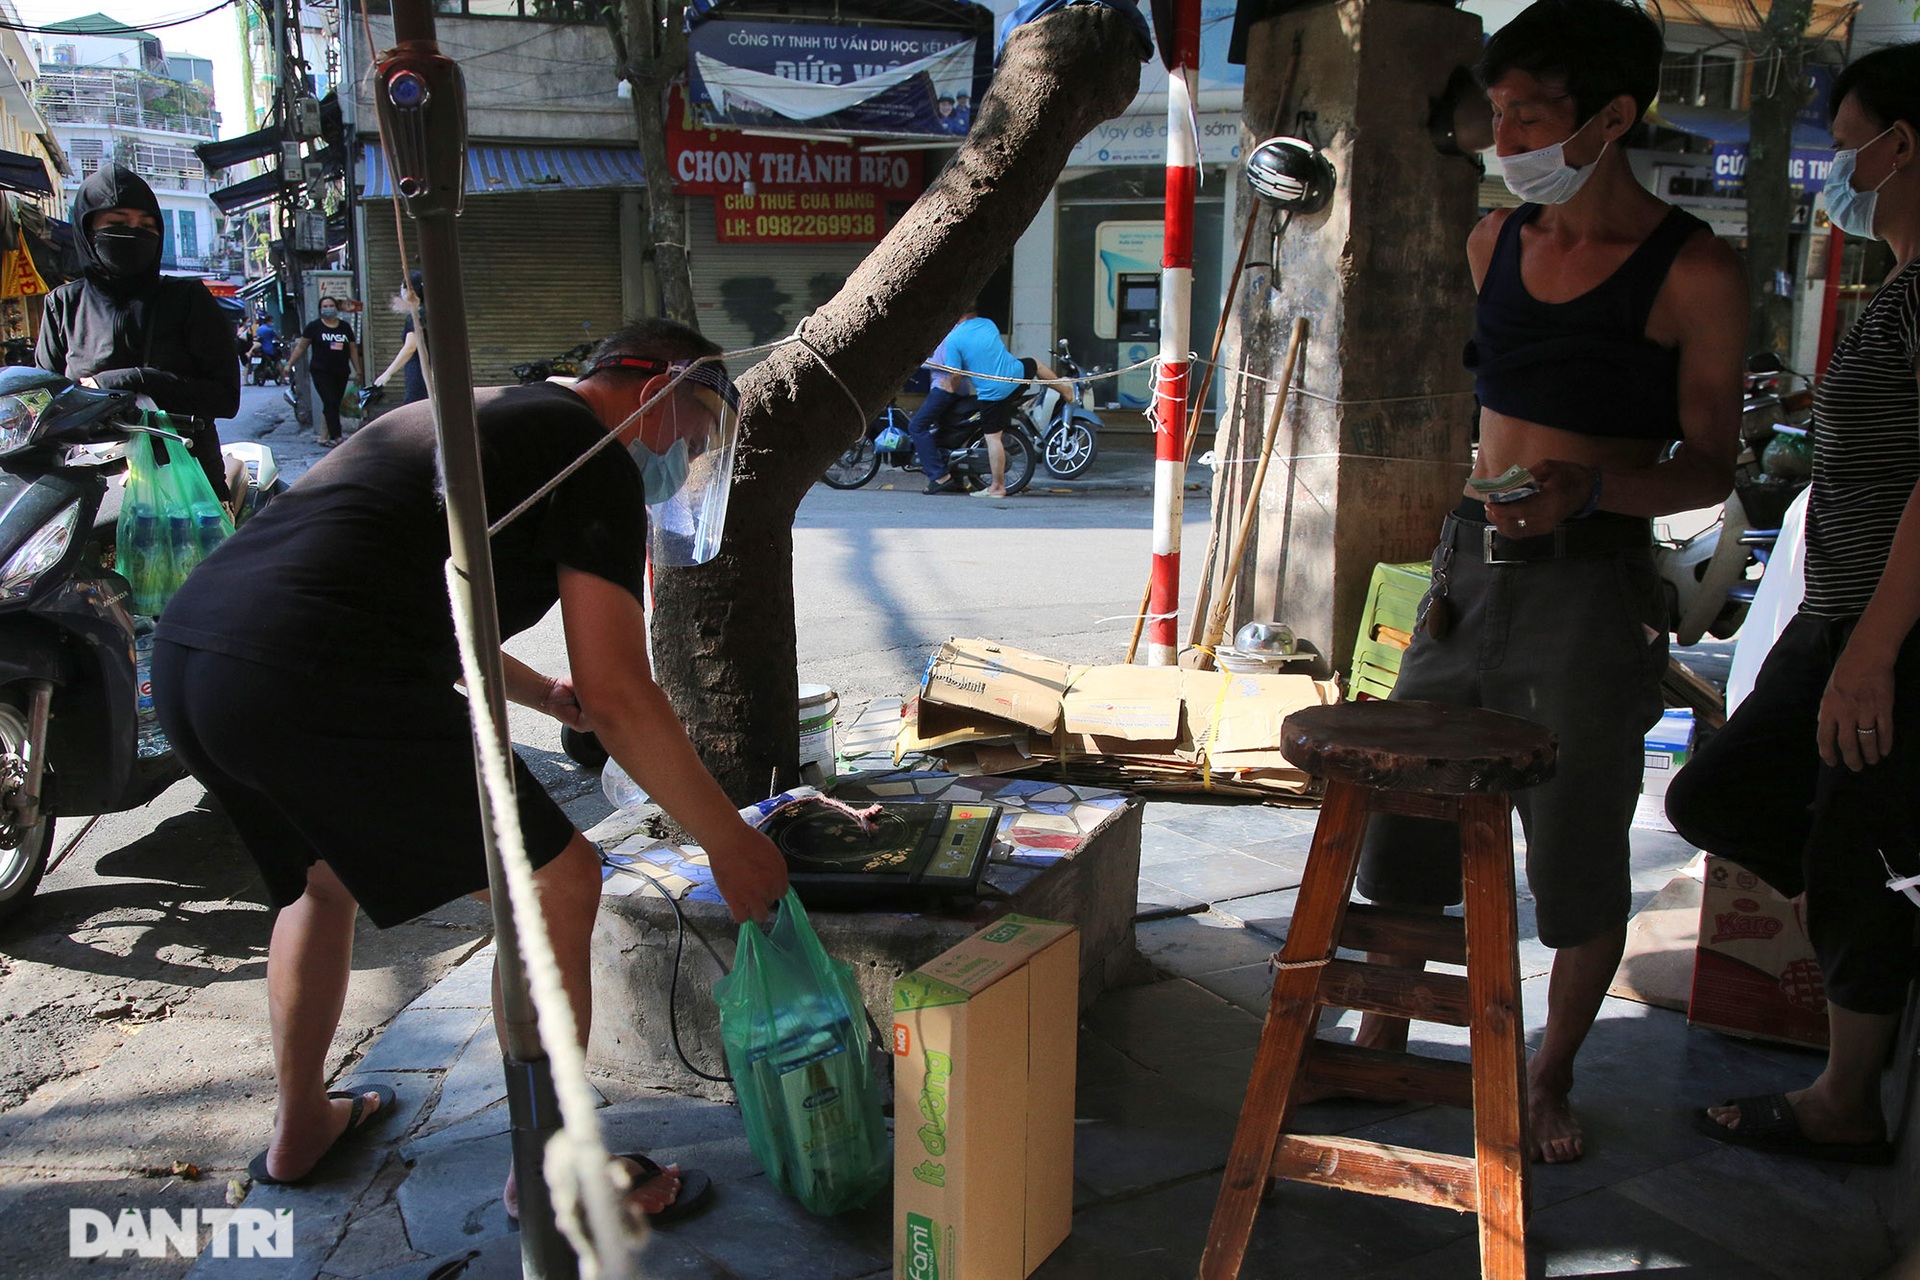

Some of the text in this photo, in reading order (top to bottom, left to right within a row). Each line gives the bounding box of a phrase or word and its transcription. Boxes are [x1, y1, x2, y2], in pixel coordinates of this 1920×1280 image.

[728, 30, 769, 46] CÔNG
[772, 35, 786, 47] TY
[789, 36, 820, 48] TNHH
[841, 34, 867, 50] VẤN
[871, 41, 888, 51] DU
[891, 41, 918, 55] HỌC
[1099, 124, 1129, 141] Vay
[1204, 121, 1237, 136] sớm
[759, 145, 852, 183] THÀNH
[725, 215, 875, 236] LH: 0982269938
[322, 333, 349, 343] NASA
[103, 590, 129, 608] HONDA
